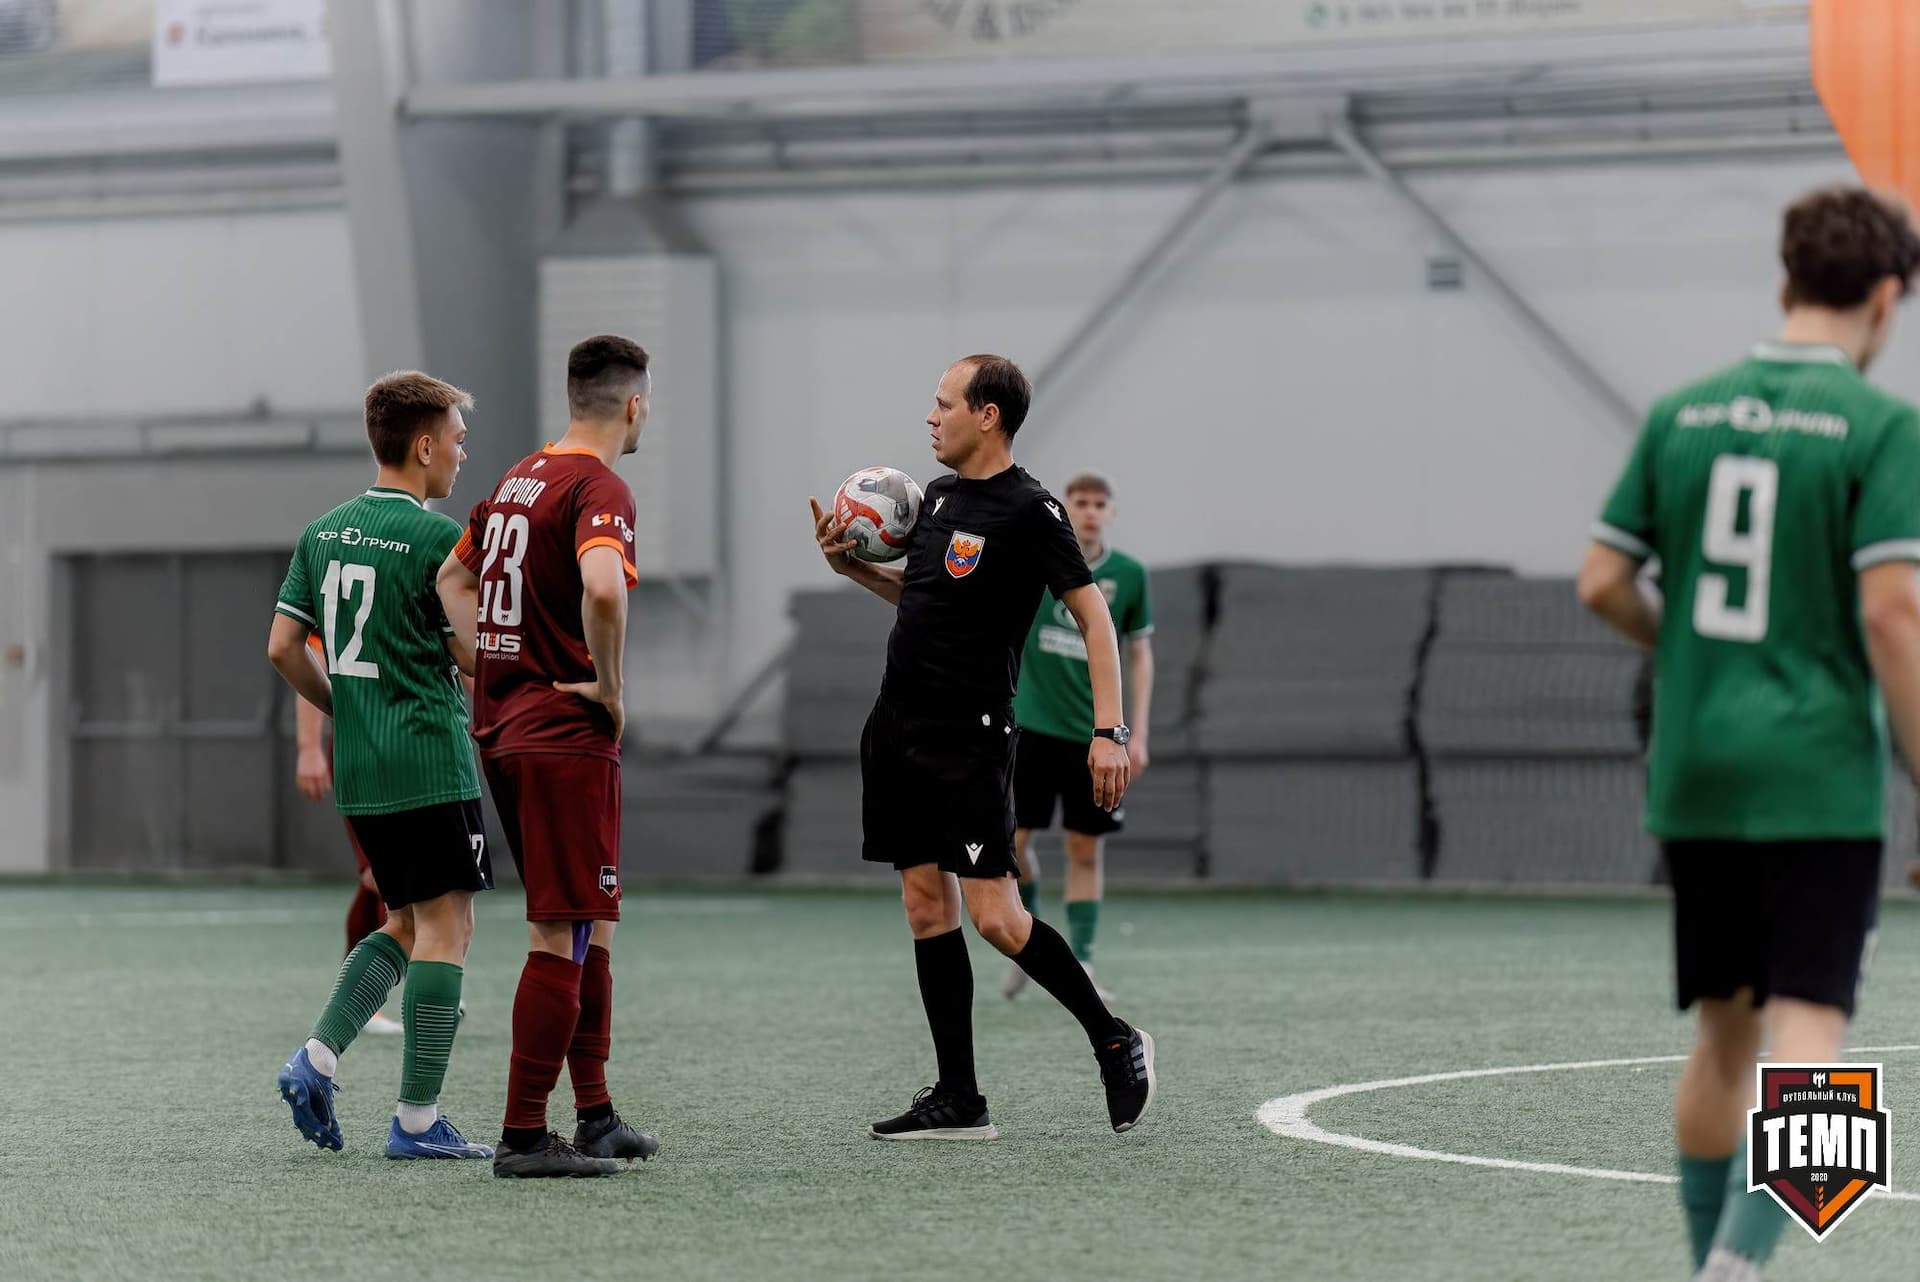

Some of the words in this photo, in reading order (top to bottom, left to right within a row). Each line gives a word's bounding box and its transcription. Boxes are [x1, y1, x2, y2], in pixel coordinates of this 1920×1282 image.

[316, 531, 338, 541] АСР
[362, 537, 411, 554] ГРУПП
[478, 513, 530, 627] 23
[1693, 452, 1779, 644] 9
[320, 559, 380, 679] 12
[501, 652, 520, 661] Union
[469, 833, 485, 881] 2
